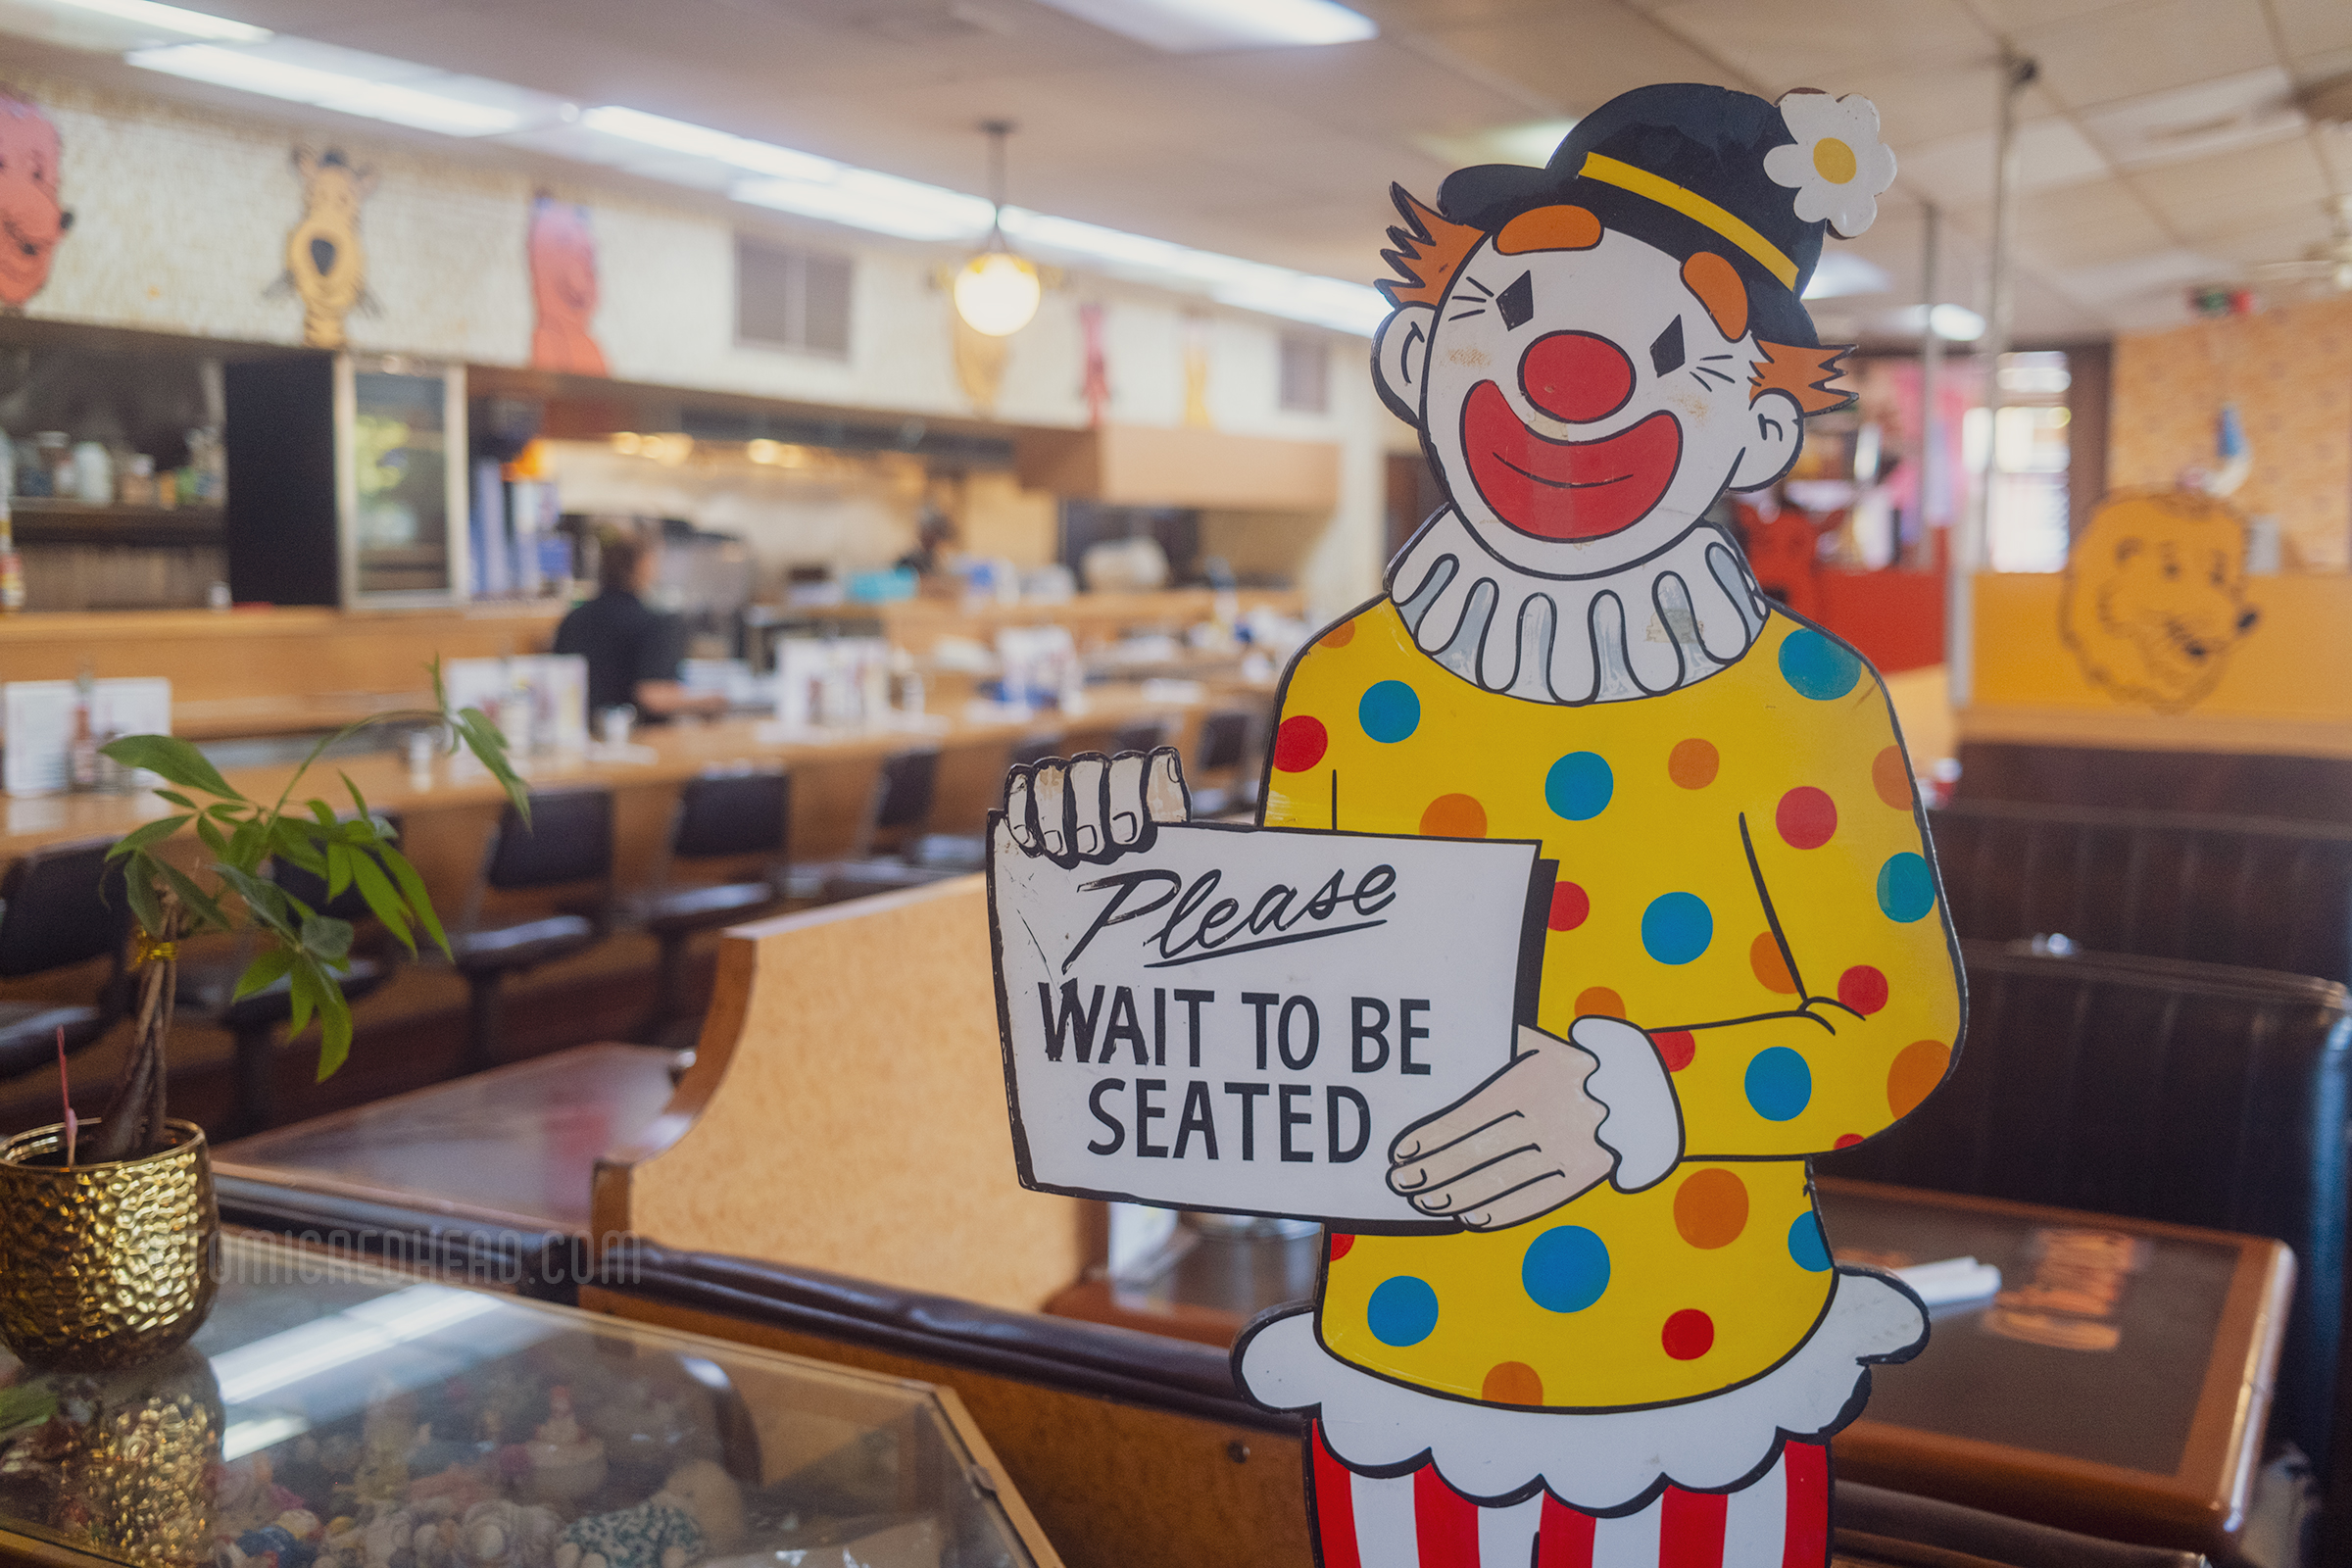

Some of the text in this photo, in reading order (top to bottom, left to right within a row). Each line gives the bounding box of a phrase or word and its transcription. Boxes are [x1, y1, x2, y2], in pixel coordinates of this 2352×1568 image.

[1061, 863, 1397, 975] Please
[1037, 979, 1432, 1076] WAIT TO BE
[1086, 1077, 1372, 1164] SEATED
